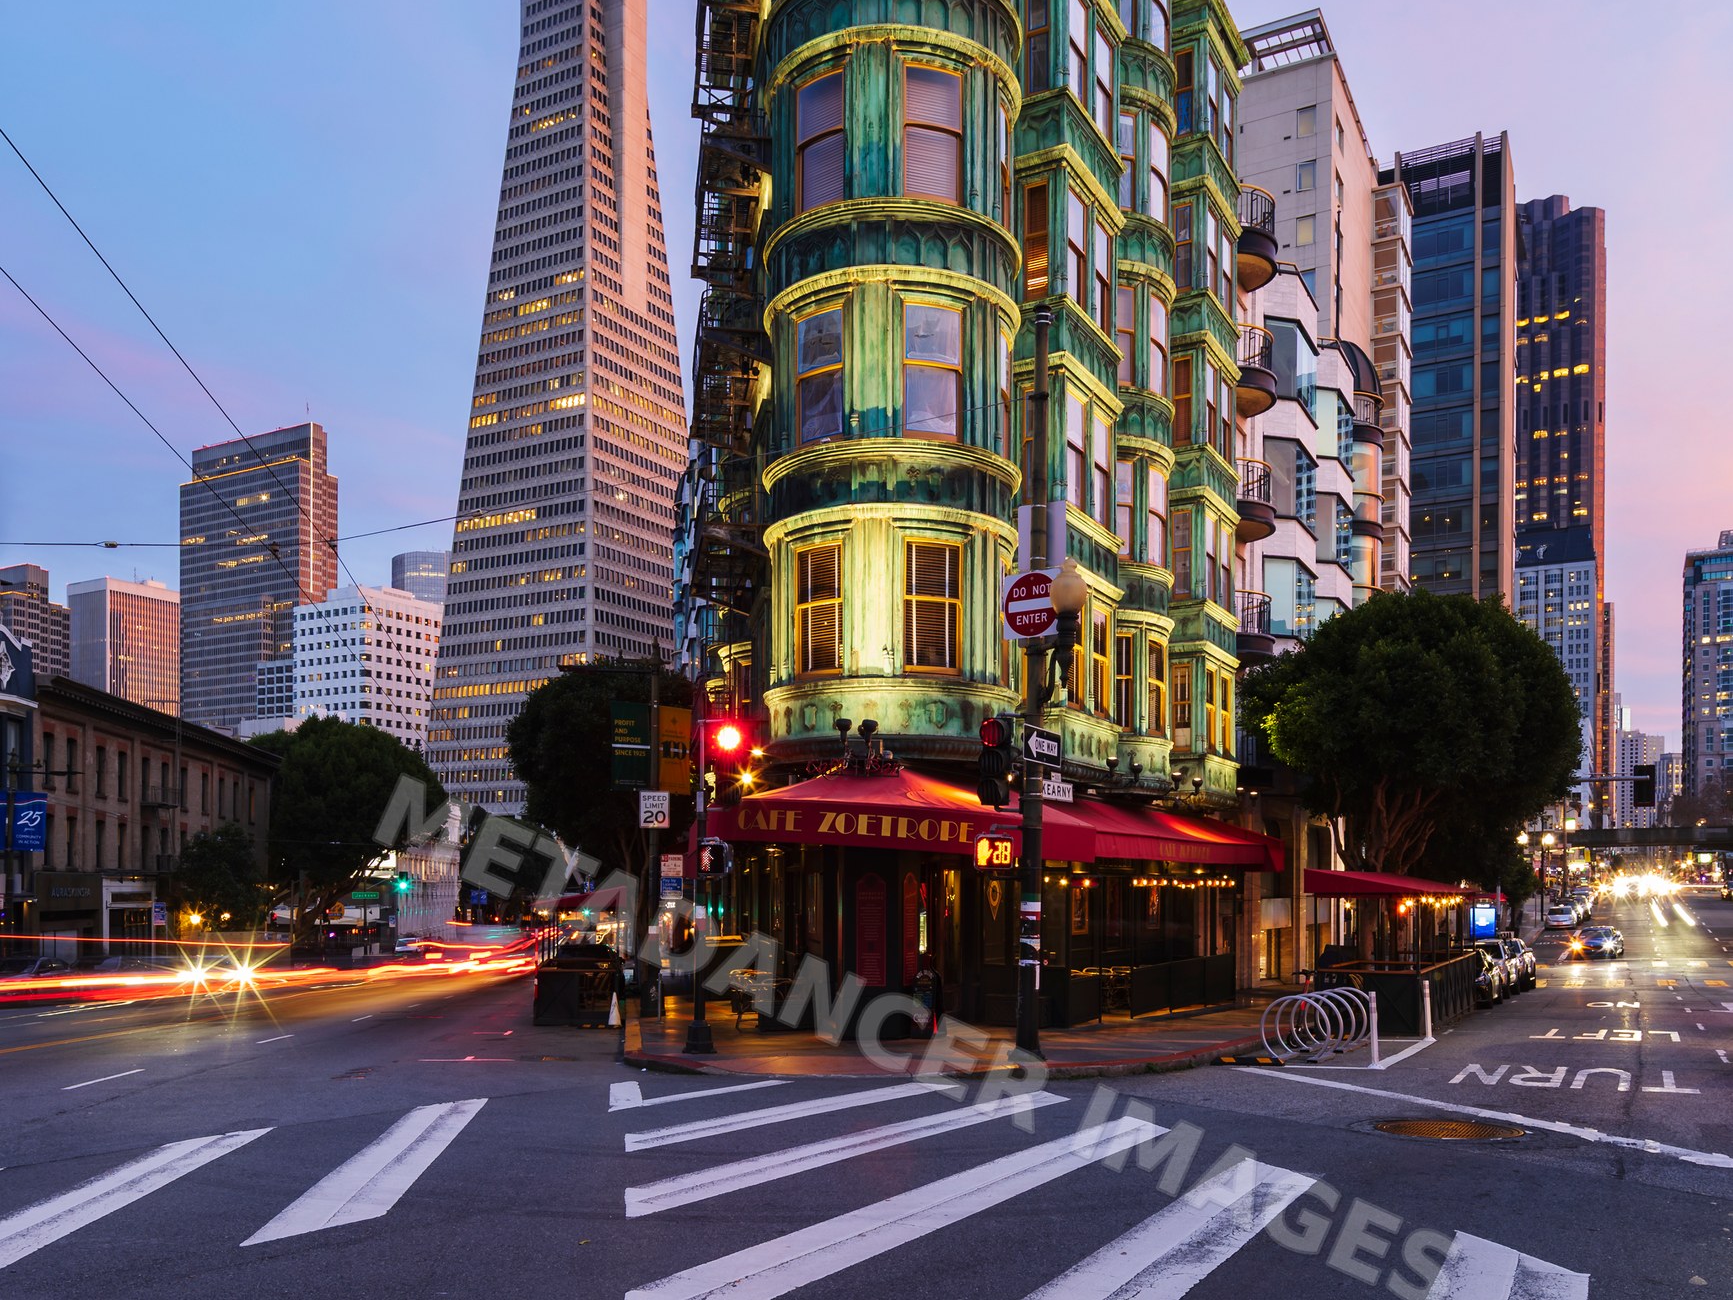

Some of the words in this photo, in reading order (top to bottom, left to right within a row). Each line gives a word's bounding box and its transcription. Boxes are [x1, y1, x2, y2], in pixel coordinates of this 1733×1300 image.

[1013, 587, 1026, 598] DO
[1032, 583, 1052, 595] NOT
[1016, 612, 1047, 625] ENTER
[1035, 739, 1045, 752] ONE
[1047, 742, 1058, 755] WAY
[1043, 781, 1072, 798] KEARNY
[17, 810, 43, 827] 25
[643, 810, 666, 823] 20
[737, 809, 802, 832] CAFE
[817, 811, 974, 843] ZOETROPE
[993, 842, 1011, 864] 28
[1586, 1001, 1640, 1009] NO
[1529, 1028, 1681, 1042] LEFT
[1448, 1063, 1701, 1094] TURN
